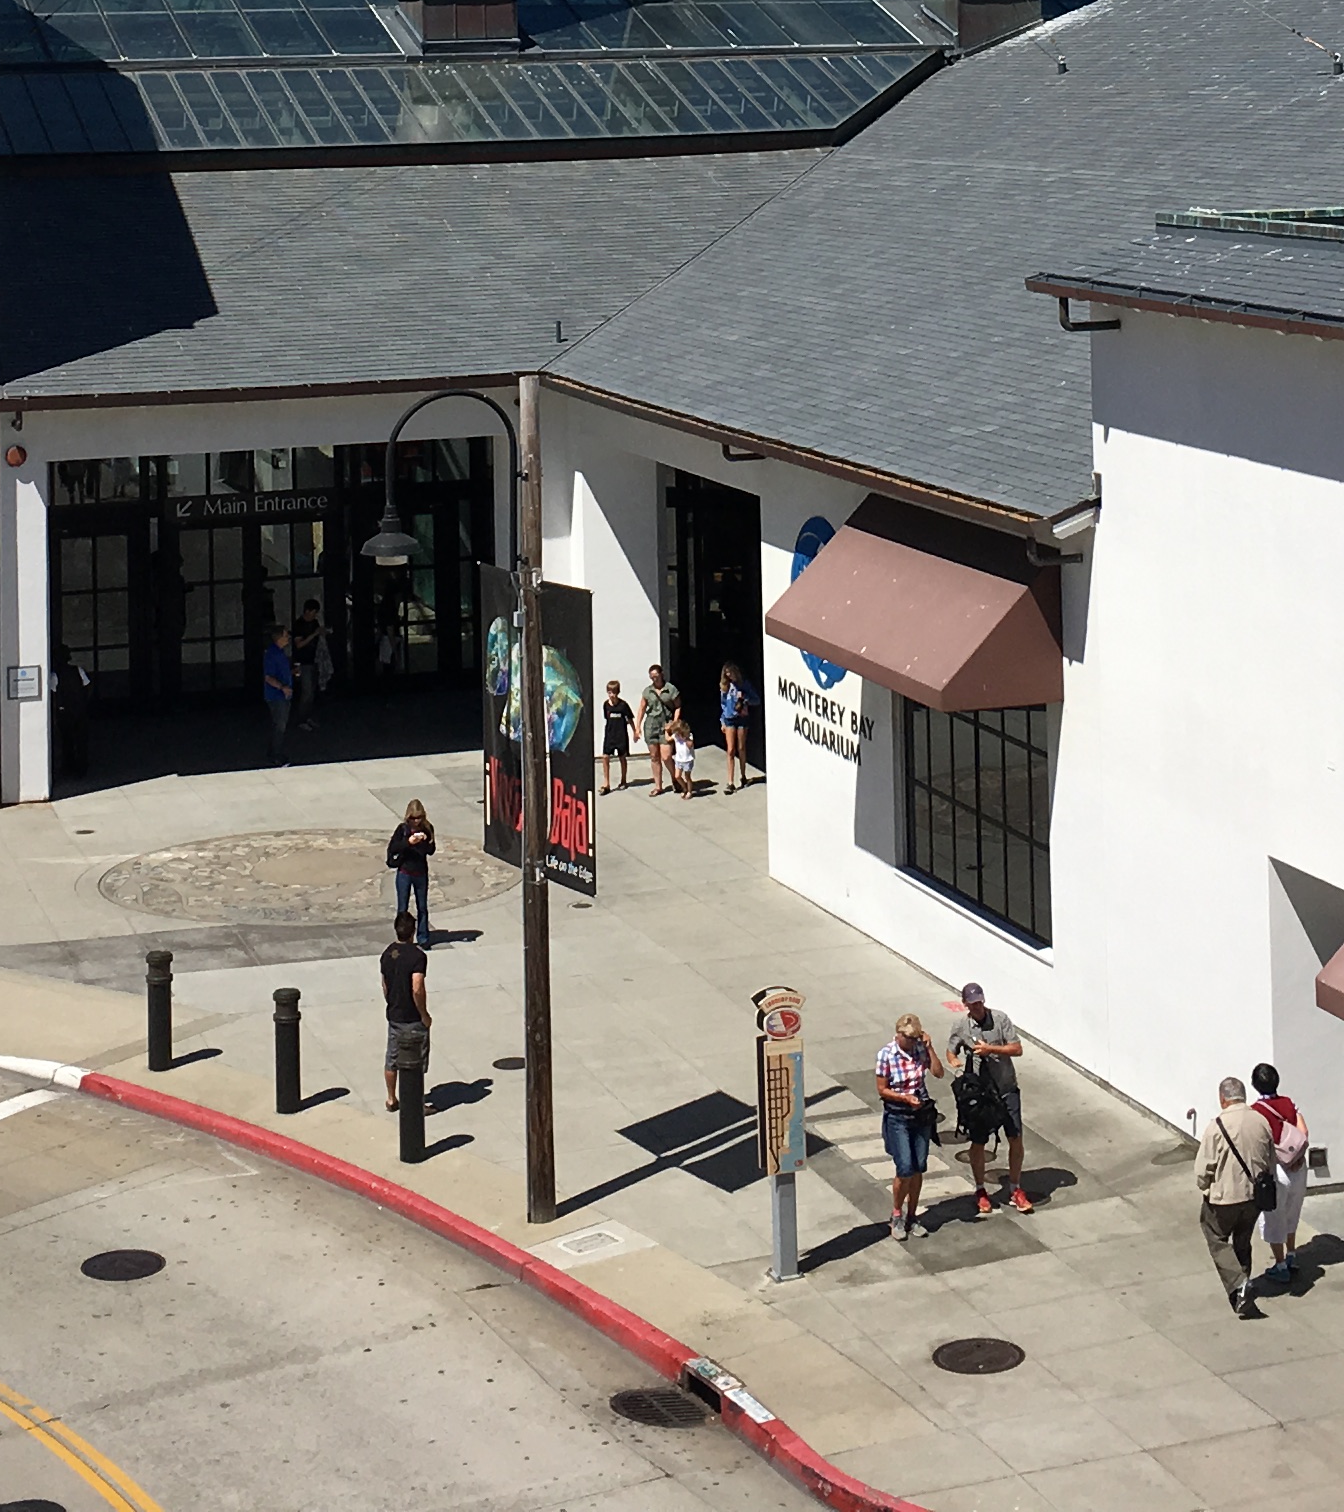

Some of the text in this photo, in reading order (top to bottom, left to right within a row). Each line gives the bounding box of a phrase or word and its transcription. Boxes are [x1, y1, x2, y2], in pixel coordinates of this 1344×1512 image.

[203, 495, 329, 515] Main Entrance
[777, 675, 875, 741] MONTEREY BAY
[793, 713, 862, 766] AQUARIUM
[549, 777, 593, 862] Baja!
